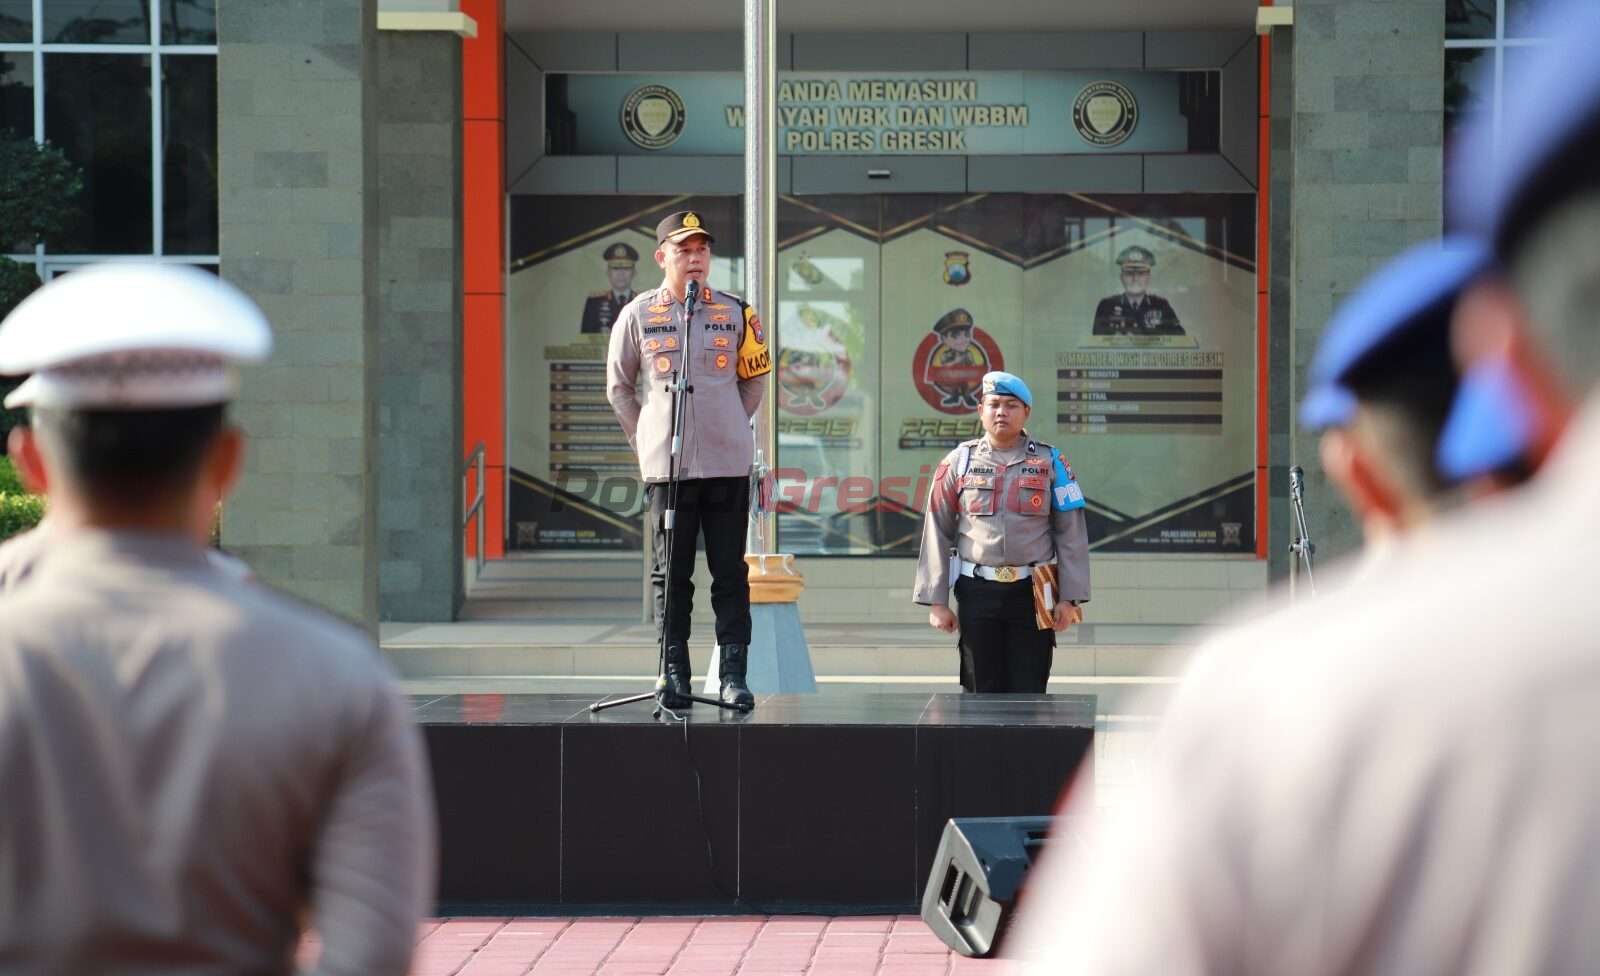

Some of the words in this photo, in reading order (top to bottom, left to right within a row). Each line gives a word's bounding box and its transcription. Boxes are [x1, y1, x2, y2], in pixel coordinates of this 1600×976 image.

[778, 80, 841, 101] ANDA
[848, 80, 977, 101] MEMASUKI
[725, 106, 829, 128] WYAH
[836, 106, 890, 128] WBK
[896, 106, 945, 128] DAN
[952, 105, 1029, 127] WBBM
[786, 129, 875, 151] POLRES
[881, 129, 967, 151] GRESIK
[704, 323, 736, 332] POLRI
[1021, 467, 1048, 475] POLRI
